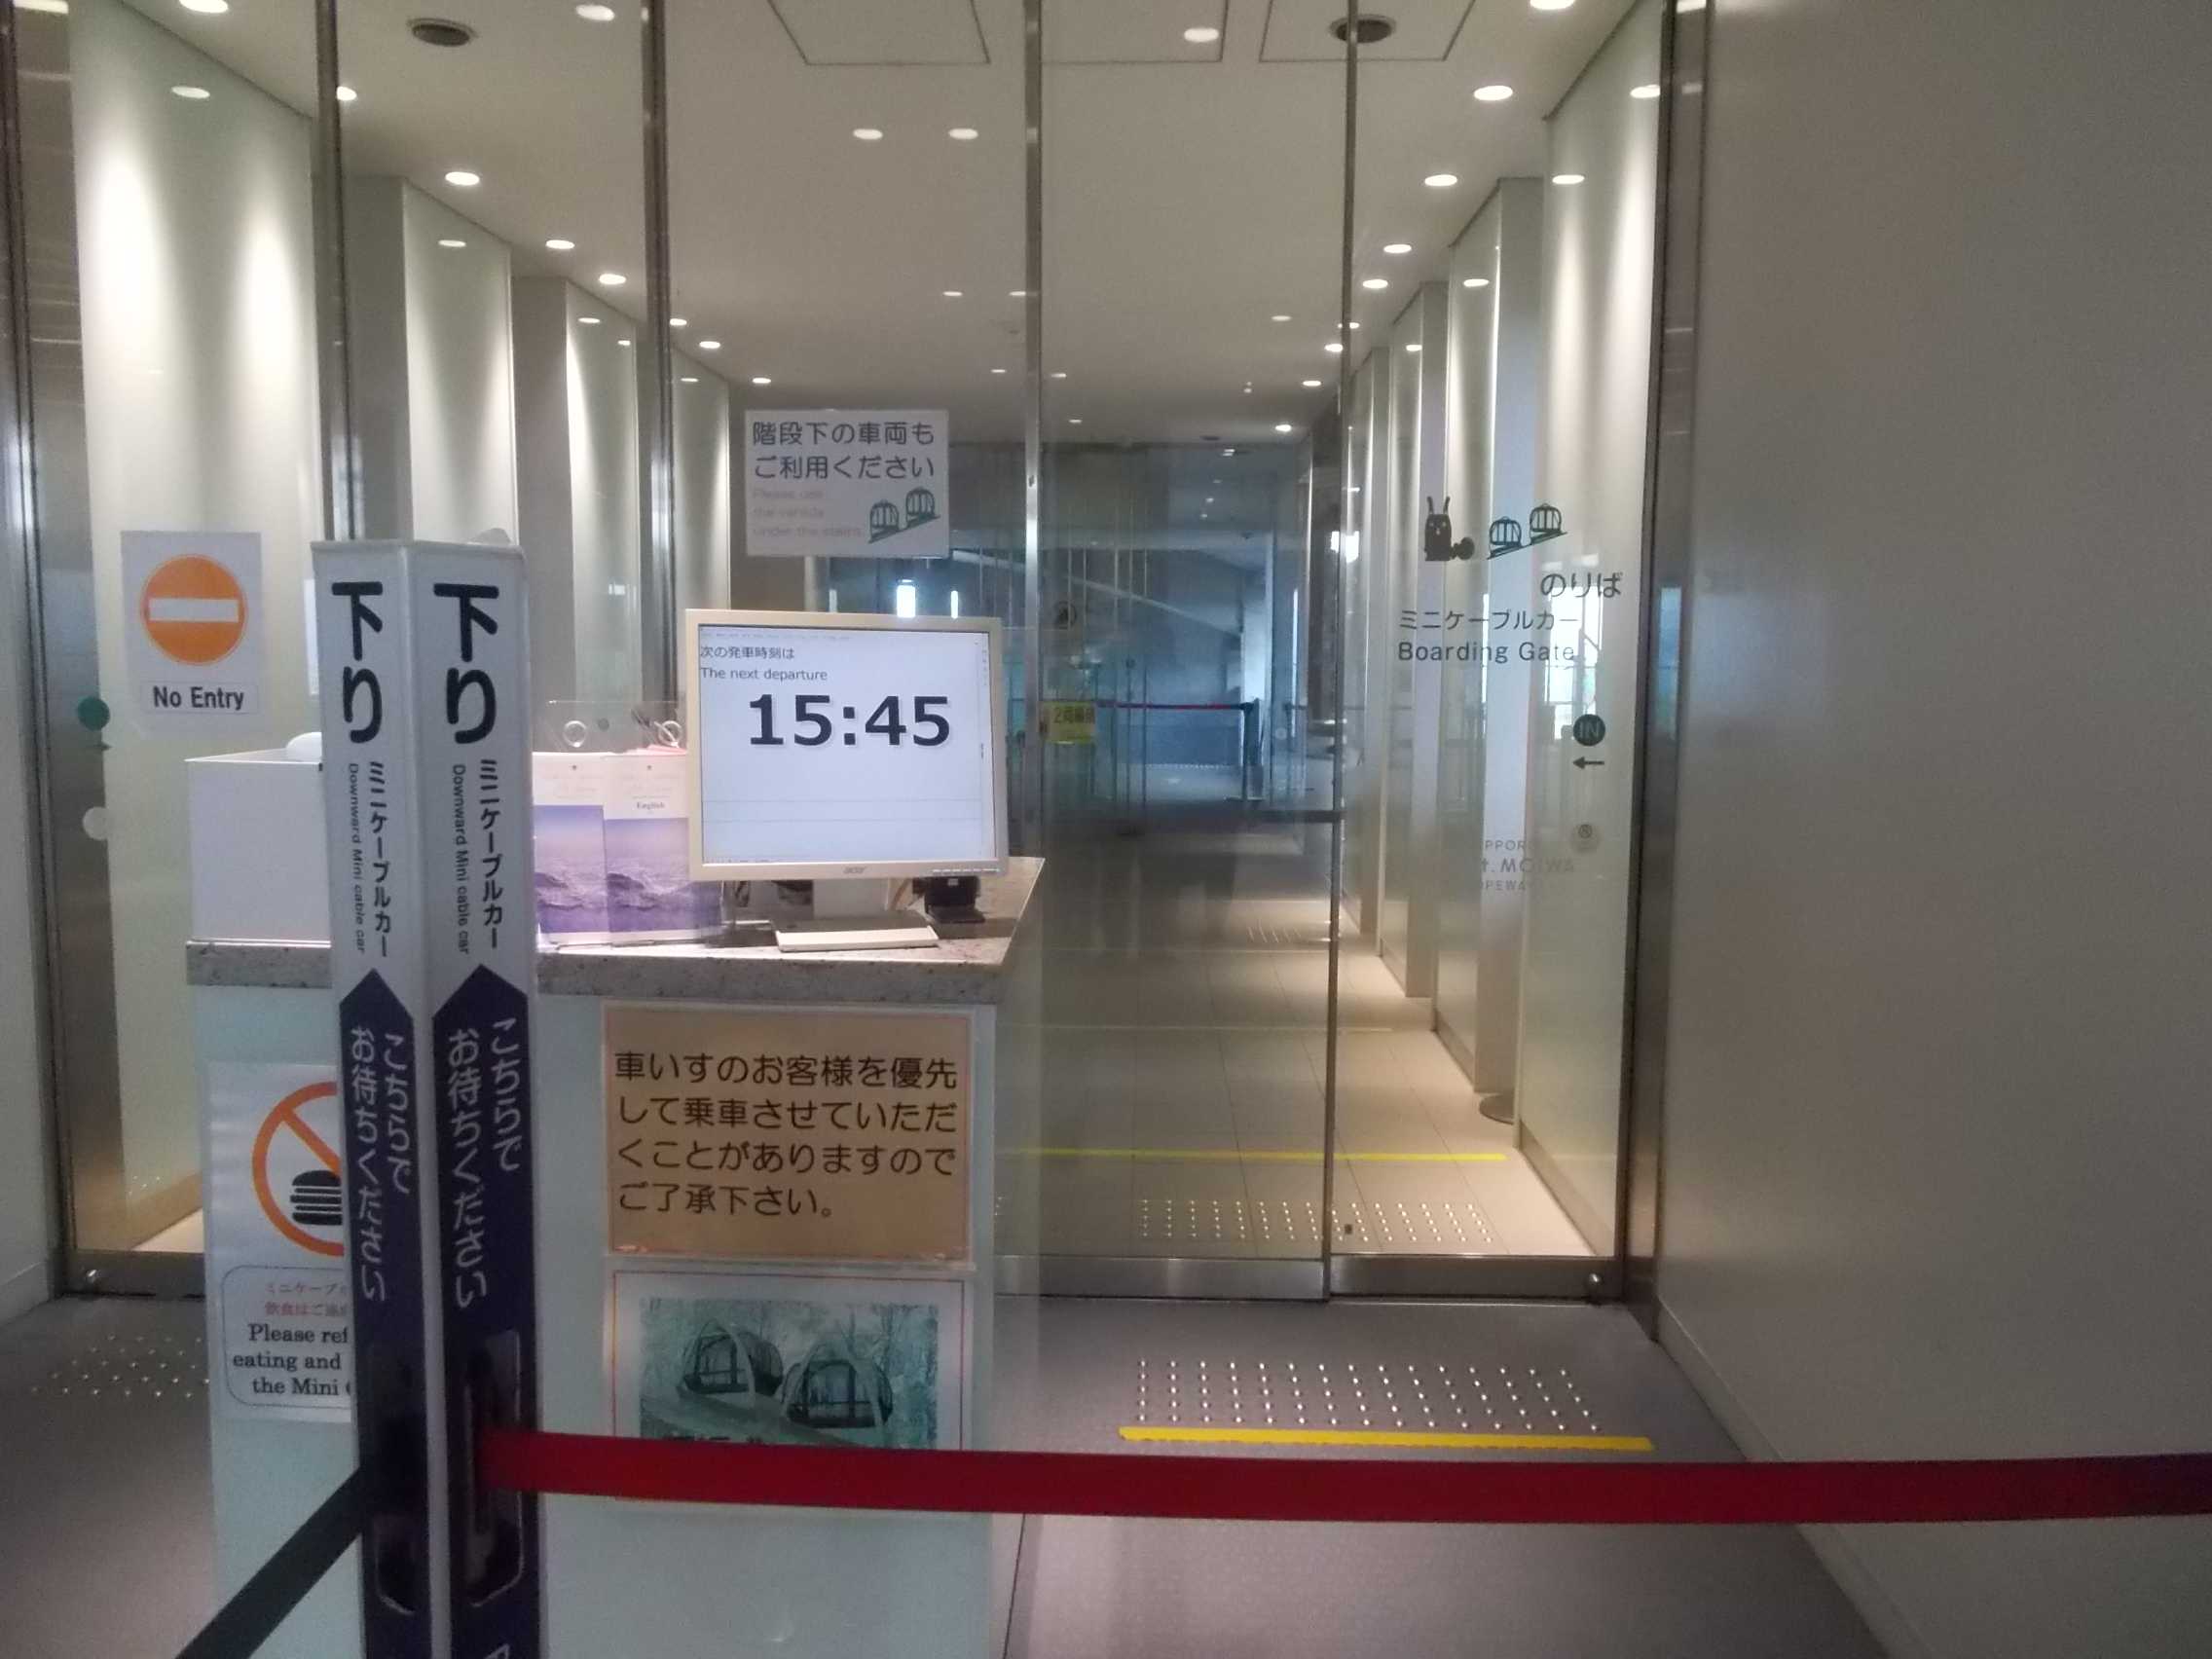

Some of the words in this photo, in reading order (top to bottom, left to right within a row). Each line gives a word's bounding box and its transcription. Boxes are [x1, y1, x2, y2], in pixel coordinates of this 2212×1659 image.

[753, 422, 934, 446] 階段下の車両も
[755, 455, 935, 480] ご利用ください
[1540, 571, 1624, 599] のりば
[1399, 609, 1579, 631] ミニケーブルカー
[331, 580, 384, 744] 下り
[433, 582, 500, 745] 下り
[700, 645, 795, 660] 次の発車時刻は
[1398, 641, 1508, 664] Boarding
[1519, 641, 1574, 661] Gate
[700, 667, 725, 680] The
[730, 668, 758, 680] next
[763, 668, 828, 683] departure
[152, 685, 182, 709] No
[190, 685, 244, 712] Entry
[749, 693, 951, 747] 15:45
[349, 763, 362, 844] Downward
[453, 763, 467, 846] Downward
[352, 849, 363, 880] Mini
[368, 760, 391, 958] ミニケーブルカー
[456, 850, 470, 882] Mini
[479, 758, 504, 950] ミニケーブルカー
[354, 884, 366, 925] cable
[457, 886, 471, 927] cable
[356, 930, 366, 954] car
[458, 931, 470, 955] car
[614, 1051, 958, 1089] 車いすのお客様を優先
[491, 1017, 521, 1172] こちらで
[619, 1096, 957, 1133] して乗車させていただ
[447, 1027, 488, 1309] お待ちください
[618, 1138, 956, 1176] くことがありますので
[619, 1181, 833, 1218] ご了承下さい。
[248, 1323, 315, 1343] Please
[233, 1350, 298, 1372] eating
[305, 1351, 341, 1370] and
[252, 1376, 285, 1394] the
[292, 1377, 339, 1396] Mini
